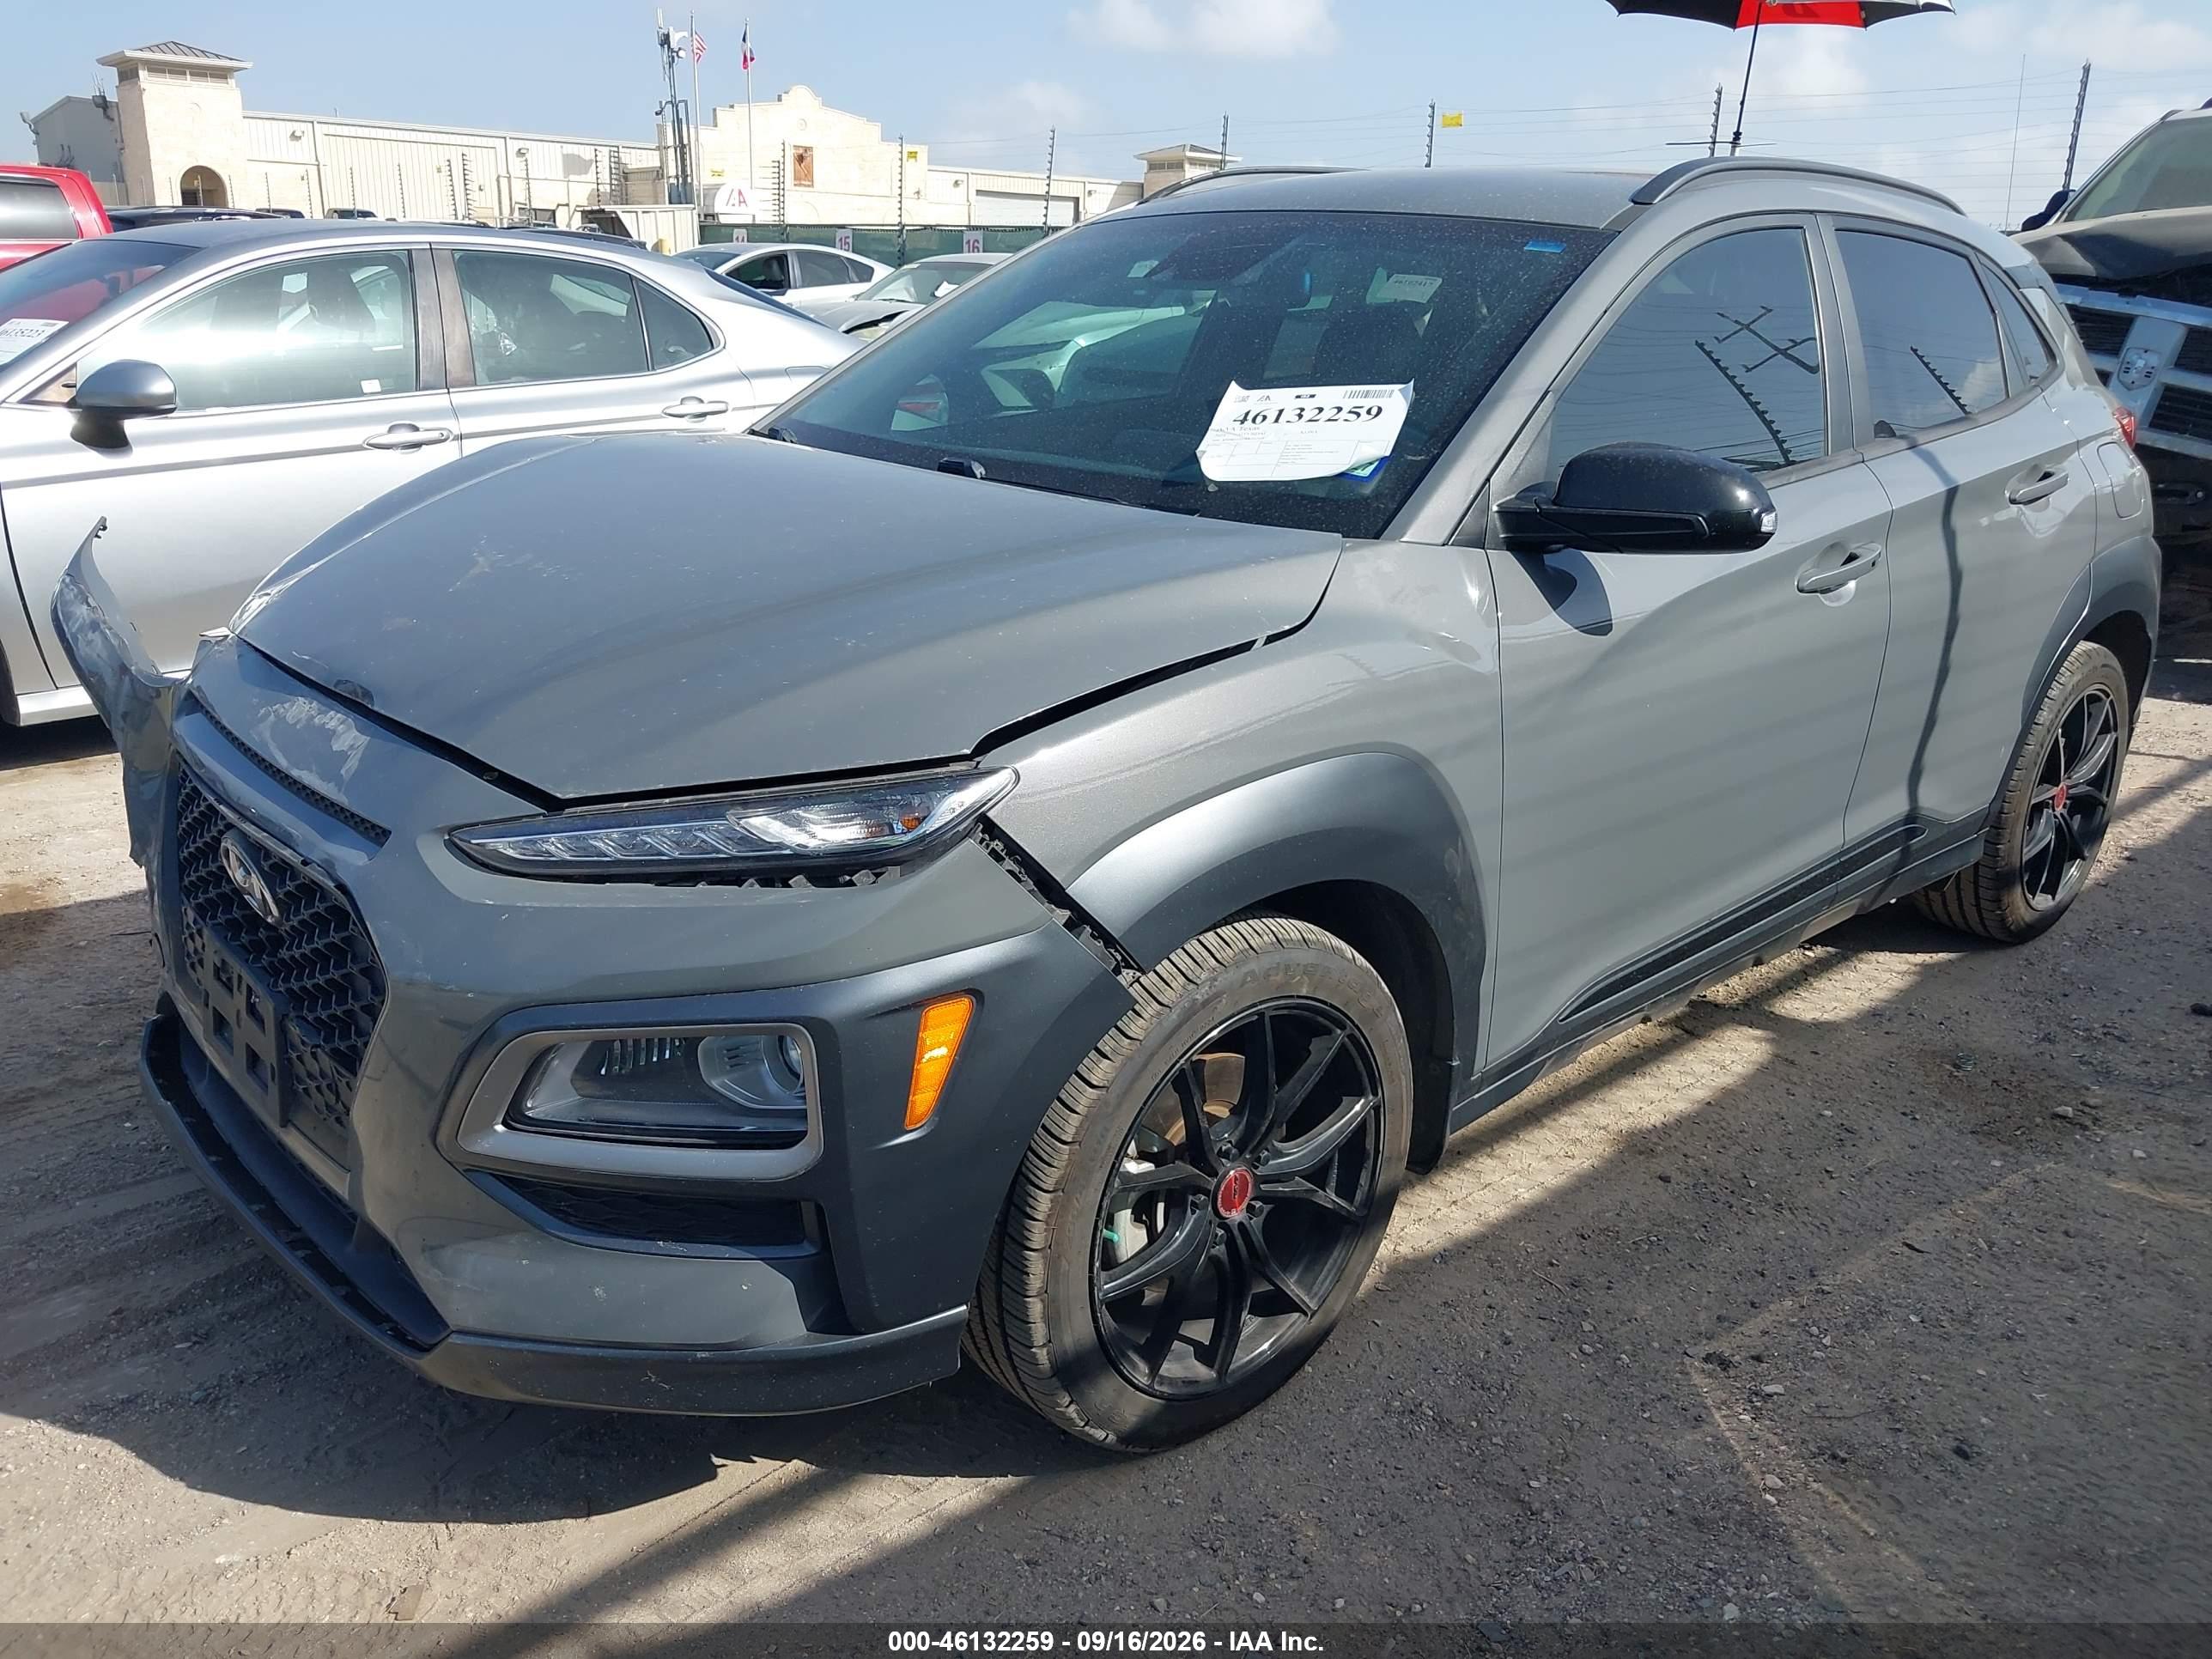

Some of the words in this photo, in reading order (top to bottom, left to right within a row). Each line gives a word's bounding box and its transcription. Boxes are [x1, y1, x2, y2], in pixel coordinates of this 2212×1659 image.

[838, 235, 851, 252] 15
[965, 239, 981, 254] 16
[1232, 405, 1382, 425] 46132259
